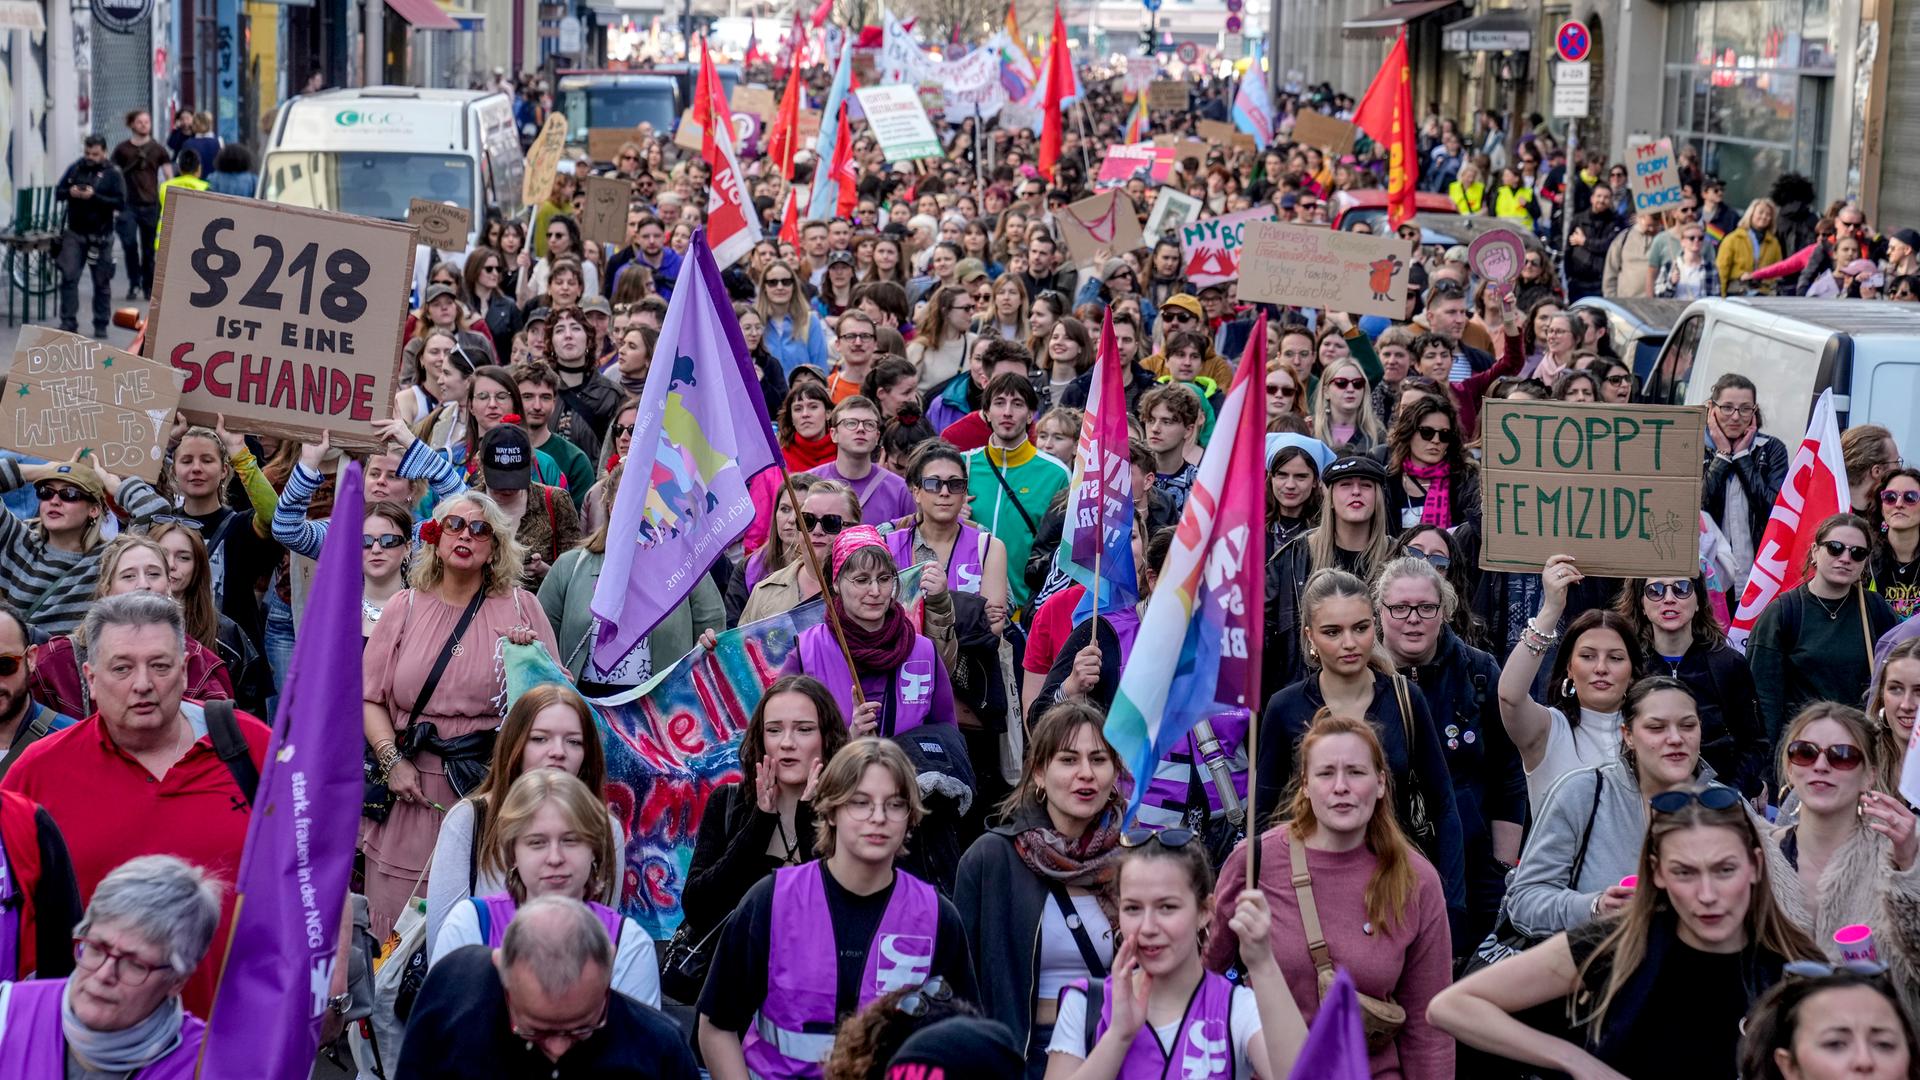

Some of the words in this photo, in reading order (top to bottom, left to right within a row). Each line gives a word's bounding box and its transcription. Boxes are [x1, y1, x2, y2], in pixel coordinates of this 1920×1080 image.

[1636, 143, 1656, 160] MY
[1636, 155, 1669, 177] BODY
[1636, 186, 1683, 209] CHOICE
[1644, 171, 1665, 190] MY
[1183, 220, 1220, 247] MY
[27, 336, 102, 374] DON'T
[215, 316, 262, 341] IST
[281, 322, 355, 355] EINE
[40, 375, 98, 409] TELL
[113, 368, 155, 406] ME
[170, 342, 376, 421] SCHANDE
[15, 403, 104, 448] WHAT
[117, 412, 145, 444] TO
[1498, 412, 1675, 472] STOPPT
[102, 442, 145, 467] DO
[1495, 482, 1653, 541] FEMIZIDE
[291, 771, 311, 816] stark.
[296, 817, 312, 867] frauen
[305, 909, 325, 949] NGG
